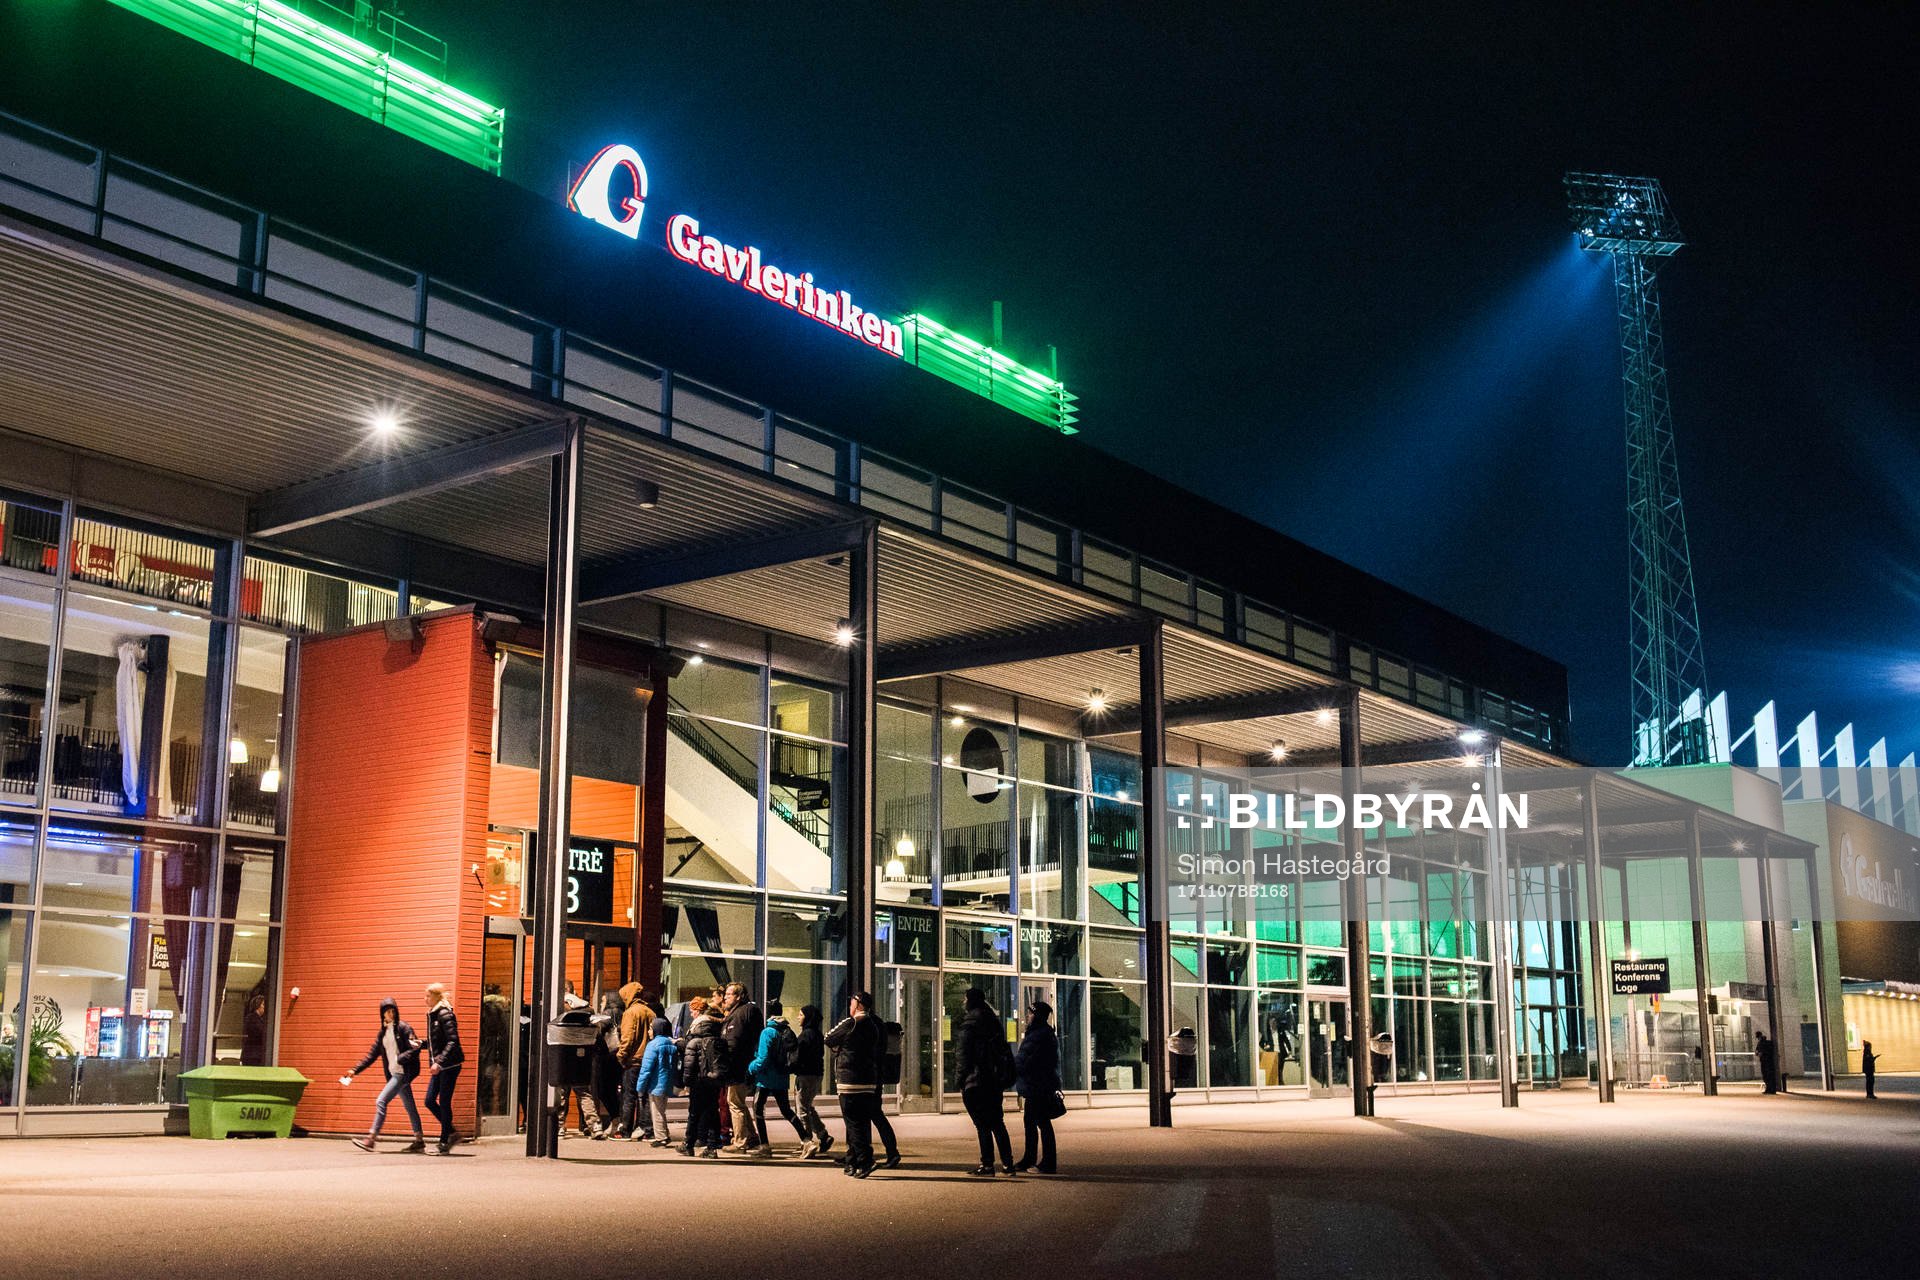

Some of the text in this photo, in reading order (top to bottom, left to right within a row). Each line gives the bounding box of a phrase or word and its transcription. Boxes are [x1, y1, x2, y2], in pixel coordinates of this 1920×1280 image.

[667, 214, 904, 358] Gavlerinken
[909, 937, 922, 961] 4
[1031, 946, 1042, 970] 5
[1614, 963, 1665, 972] Restaurang
[1614, 973, 1661, 982] Konferens
[1615, 983, 1638, 993] Loge
[240, 1106, 271, 1121] SAND
